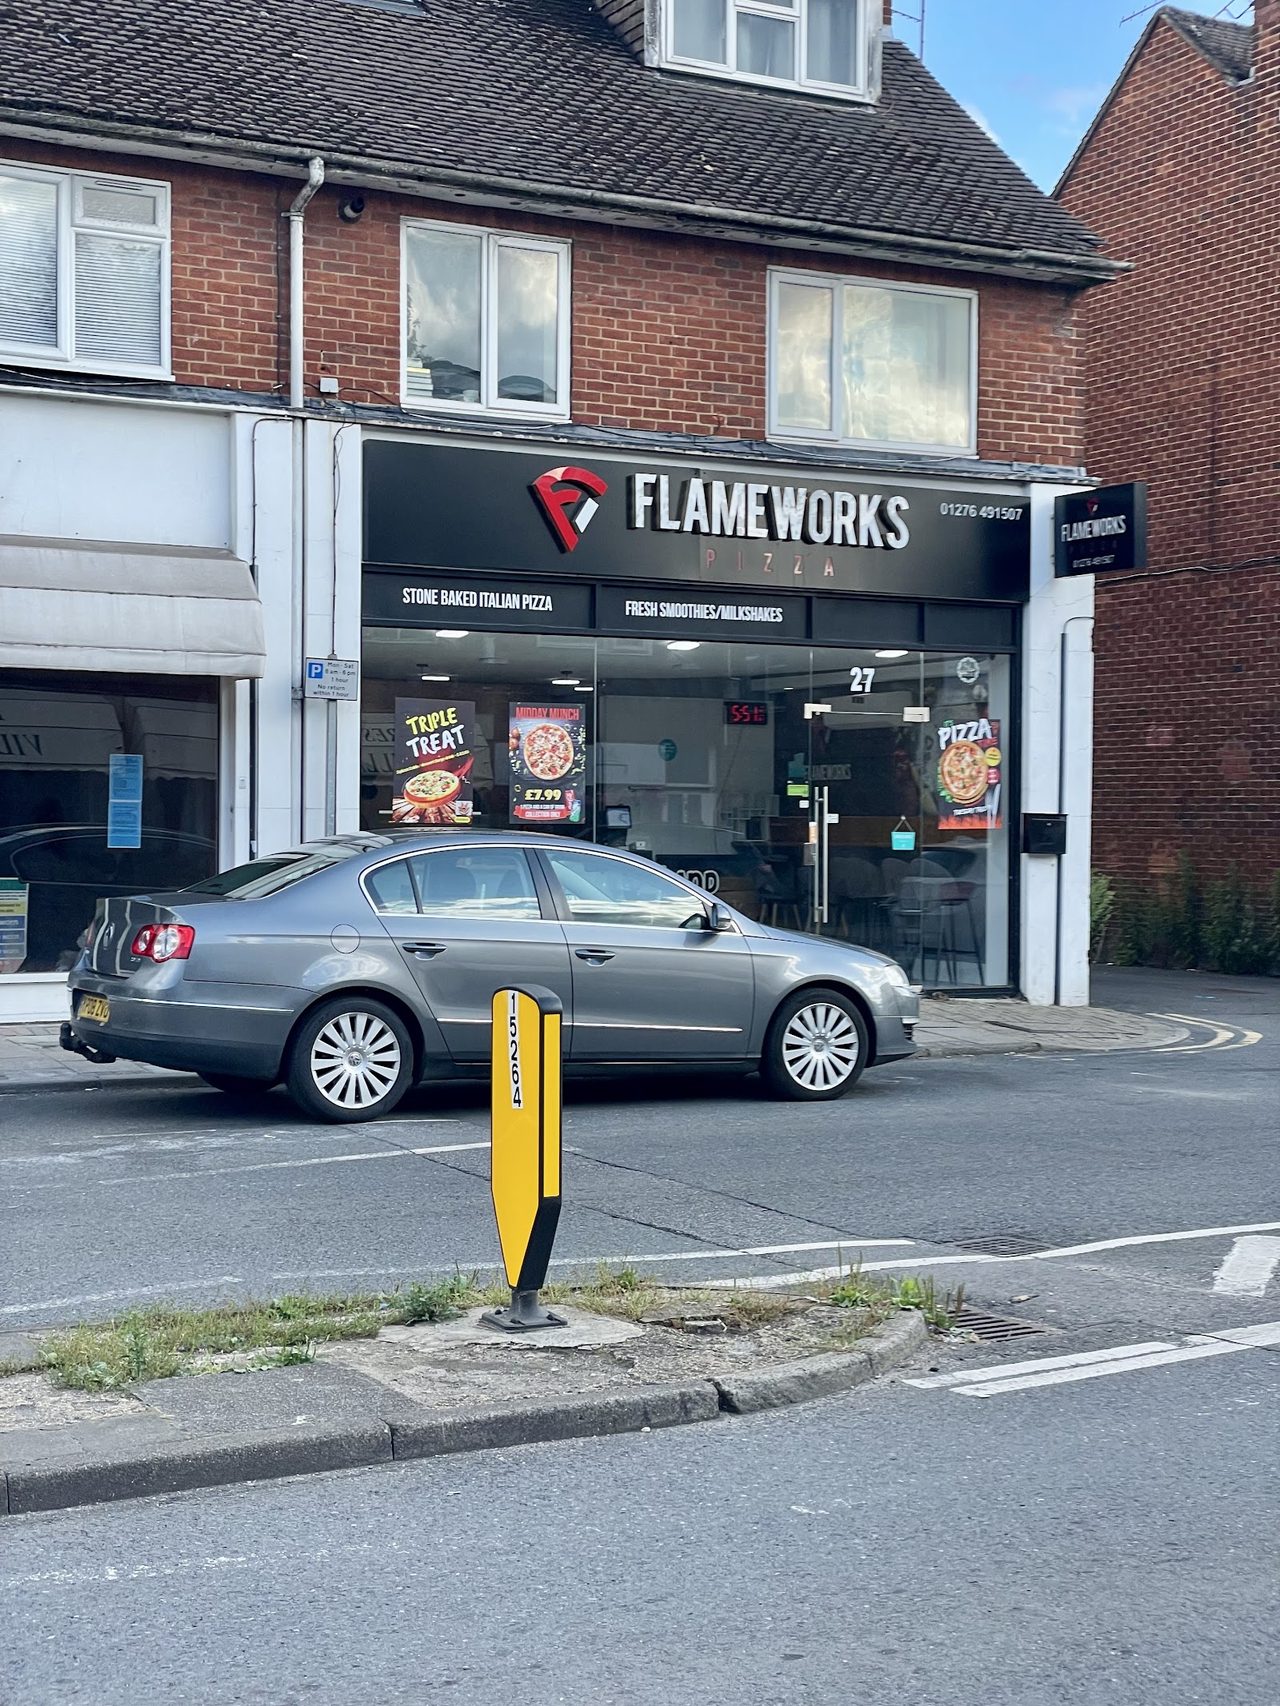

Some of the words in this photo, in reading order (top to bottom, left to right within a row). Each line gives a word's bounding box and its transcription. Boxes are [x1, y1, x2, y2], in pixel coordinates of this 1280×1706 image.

[630, 472, 911, 550] FLAMEWORKS
[940, 502, 978, 517] 01276
[979, 505, 1023, 520] 491507
[1061, 515, 1127, 542] FLAMEWORKS
[706, 549, 835, 577] PIZZA
[402, 587, 439, 605] STONE
[440, 589, 478, 607] BAKED
[479, 591, 520, 610] ITALIAN
[522, 594, 553, 612] PIZZA
[625, 600, 658, 617] FRESH
[850, 667, 875, 692] 27
[405, 707, 458, 735] TRIPLE
[516, 706, 548, 719] MIDDAY
[549, 708, 580, 721] MUNCH
[405, 724, 465, 758] TREAT
[937, 718, 993, 750] PIZZA
[524, 788, 562, 801] £7.99
[509, 992, 522, 1108] 15264
